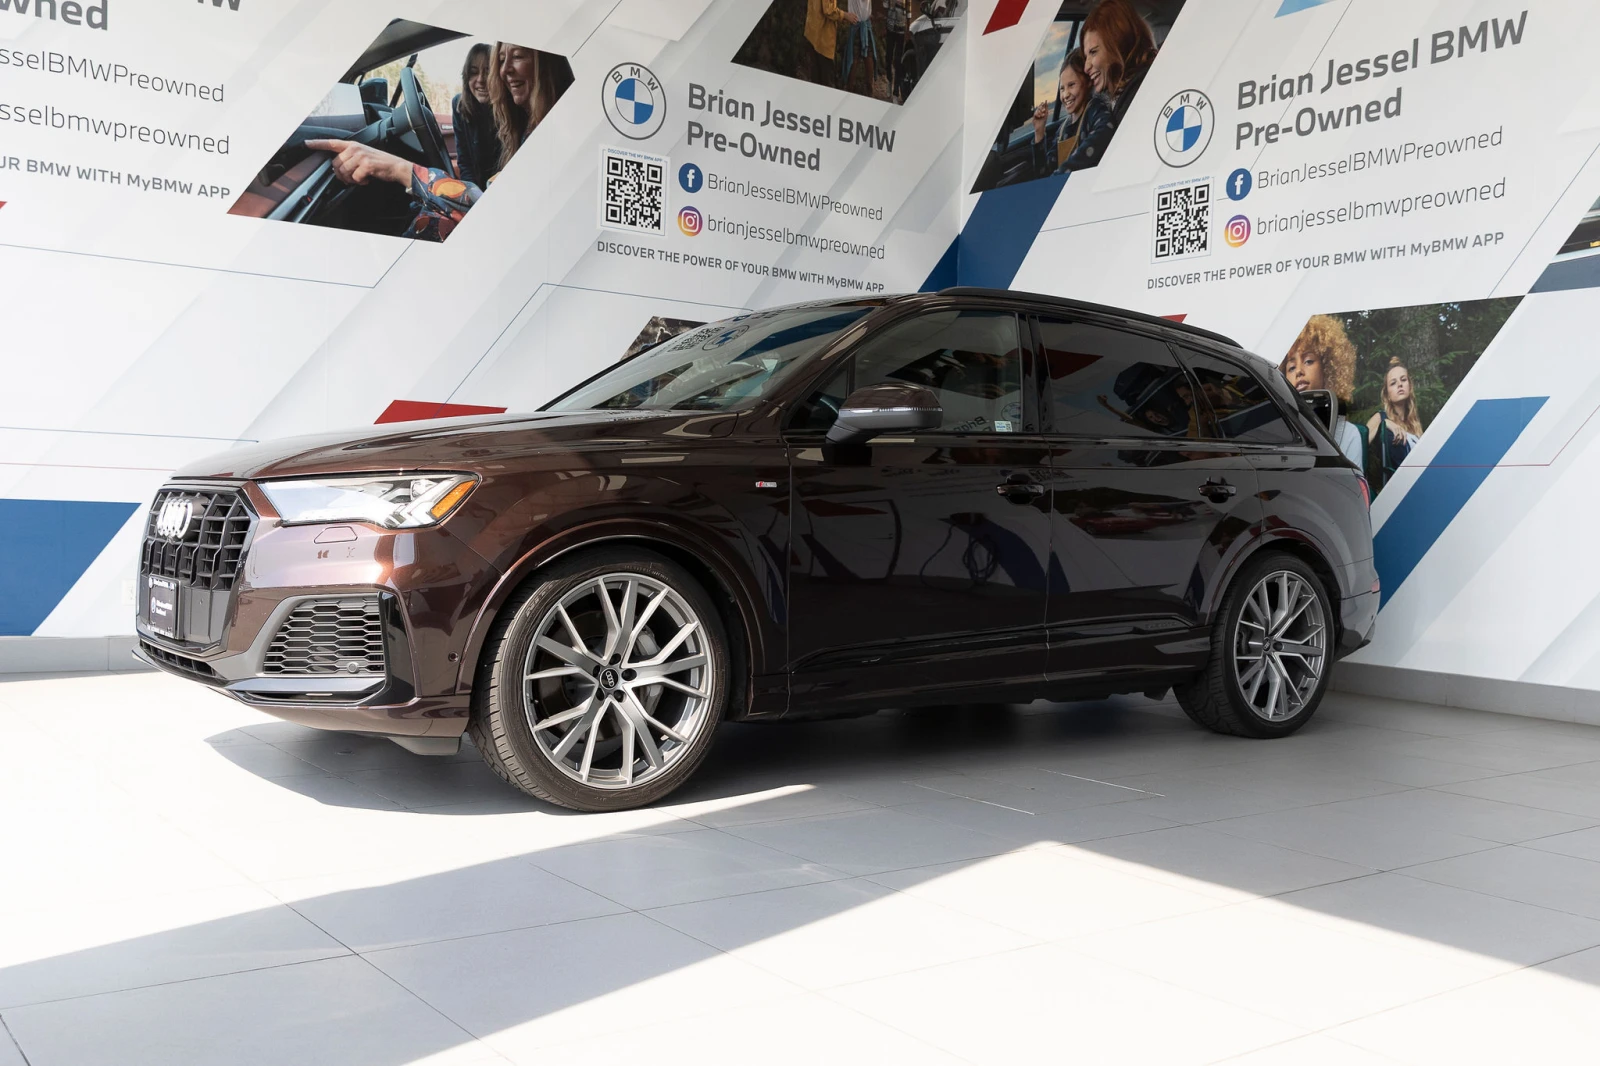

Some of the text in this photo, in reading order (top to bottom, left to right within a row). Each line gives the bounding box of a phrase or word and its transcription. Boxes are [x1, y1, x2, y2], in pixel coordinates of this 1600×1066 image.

[1237, 10, 1528, 110] Brian Jessel BMW
[687, 120, 820, 171] Pre-Owned
[688, 82, 896, 153] Brian Jessel BMW
[1235, 87, 1402, 151] Pre-Owned
[27, 159, 71, 178] BMW
[76, 166, 121, 185] WITH
[127, 174, 193, 195] MyBMW
[197, 184, 231, 200] APP
[1257, 125, 1503, 189] BrianJesselBMWPreowned
[708, 173, 883, 221] BrianJesselBMWPreowned
[1257, 177, 1506, 236] brianjesselbmwpreowned
[707, 214, 885, 260] brianjesselbmwpreowned
[1147, 231, 1504, 290] DISCOVER THE POWER OF YOUR BMW WITH MyBMW APP
[597, 241, 885, 293] DISCOVER THE POWER OF YOUR BMW WITH MyBMW APP
